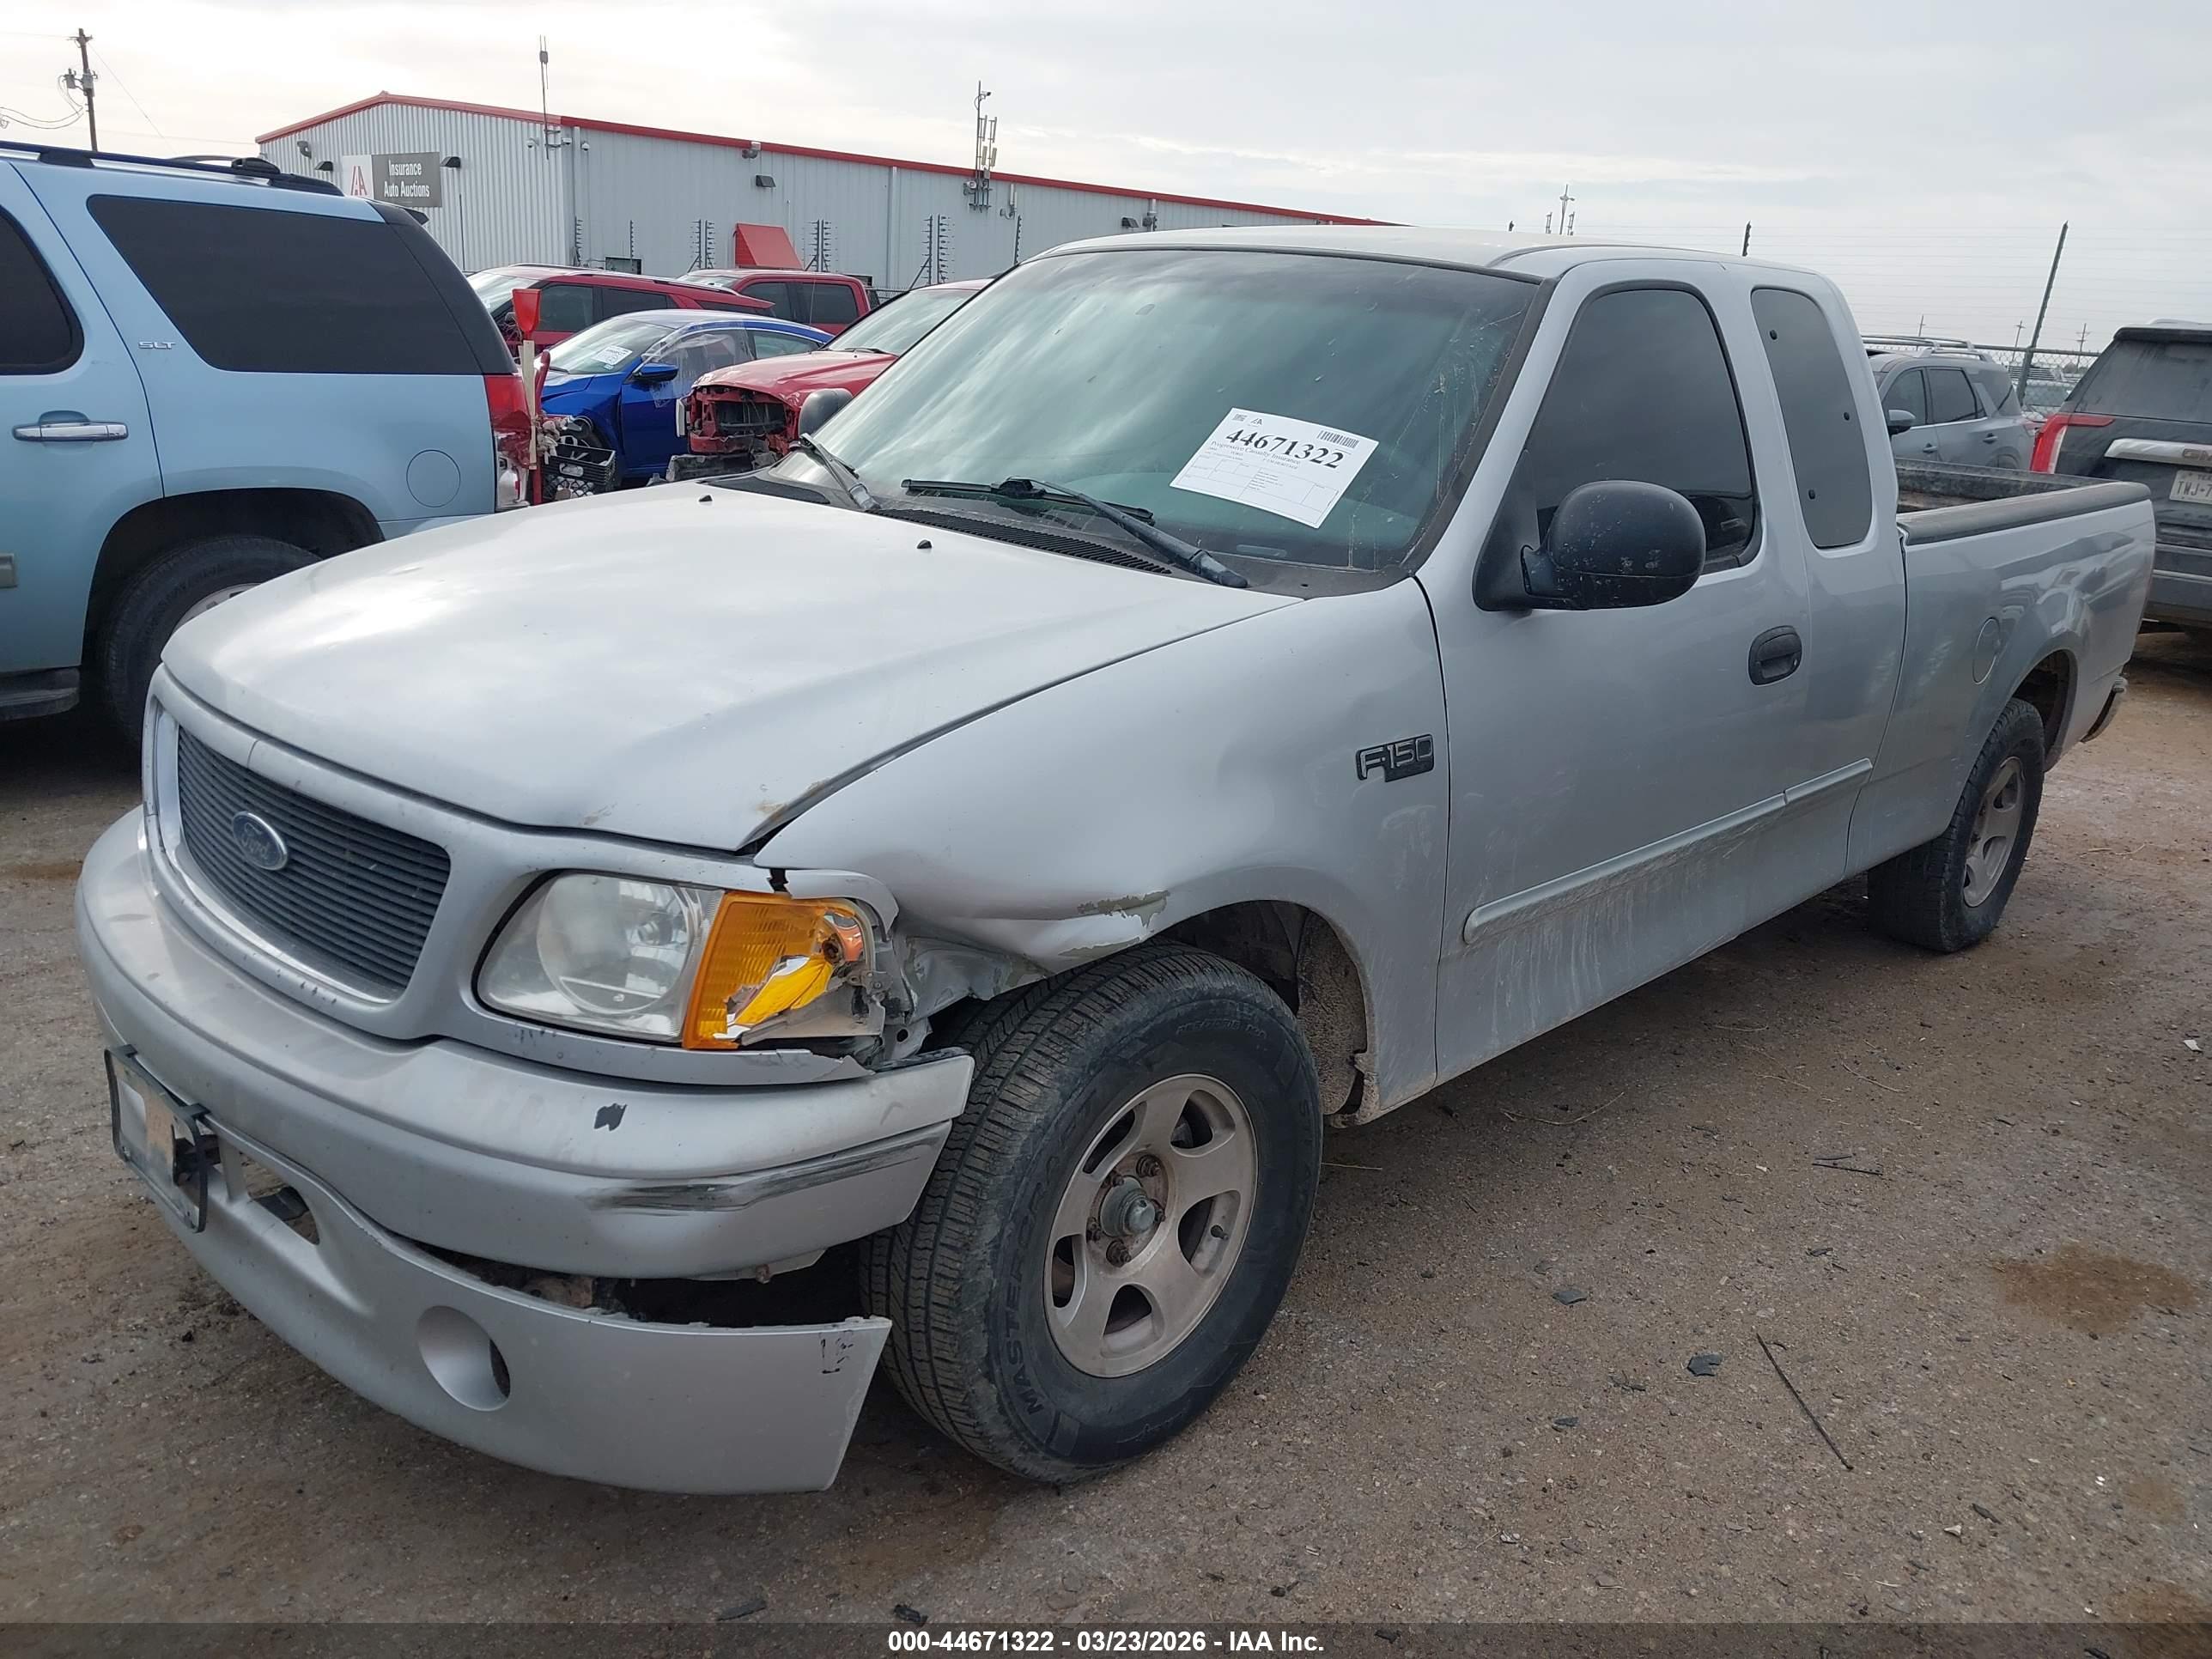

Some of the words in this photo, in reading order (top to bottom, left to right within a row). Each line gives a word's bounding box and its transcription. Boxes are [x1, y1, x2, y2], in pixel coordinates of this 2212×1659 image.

[389, 159, 422, 176] Insurance
[384, 180, 398, 198] Auto
[400, 180, 430, 198] Auctions
[138, 341, 176, 349] SLT
[1225, 428, 1345, 469] 44671322
[1245, 447, 1271, 458] Casualty
[1271, 453, 1302, 465] Insurance
